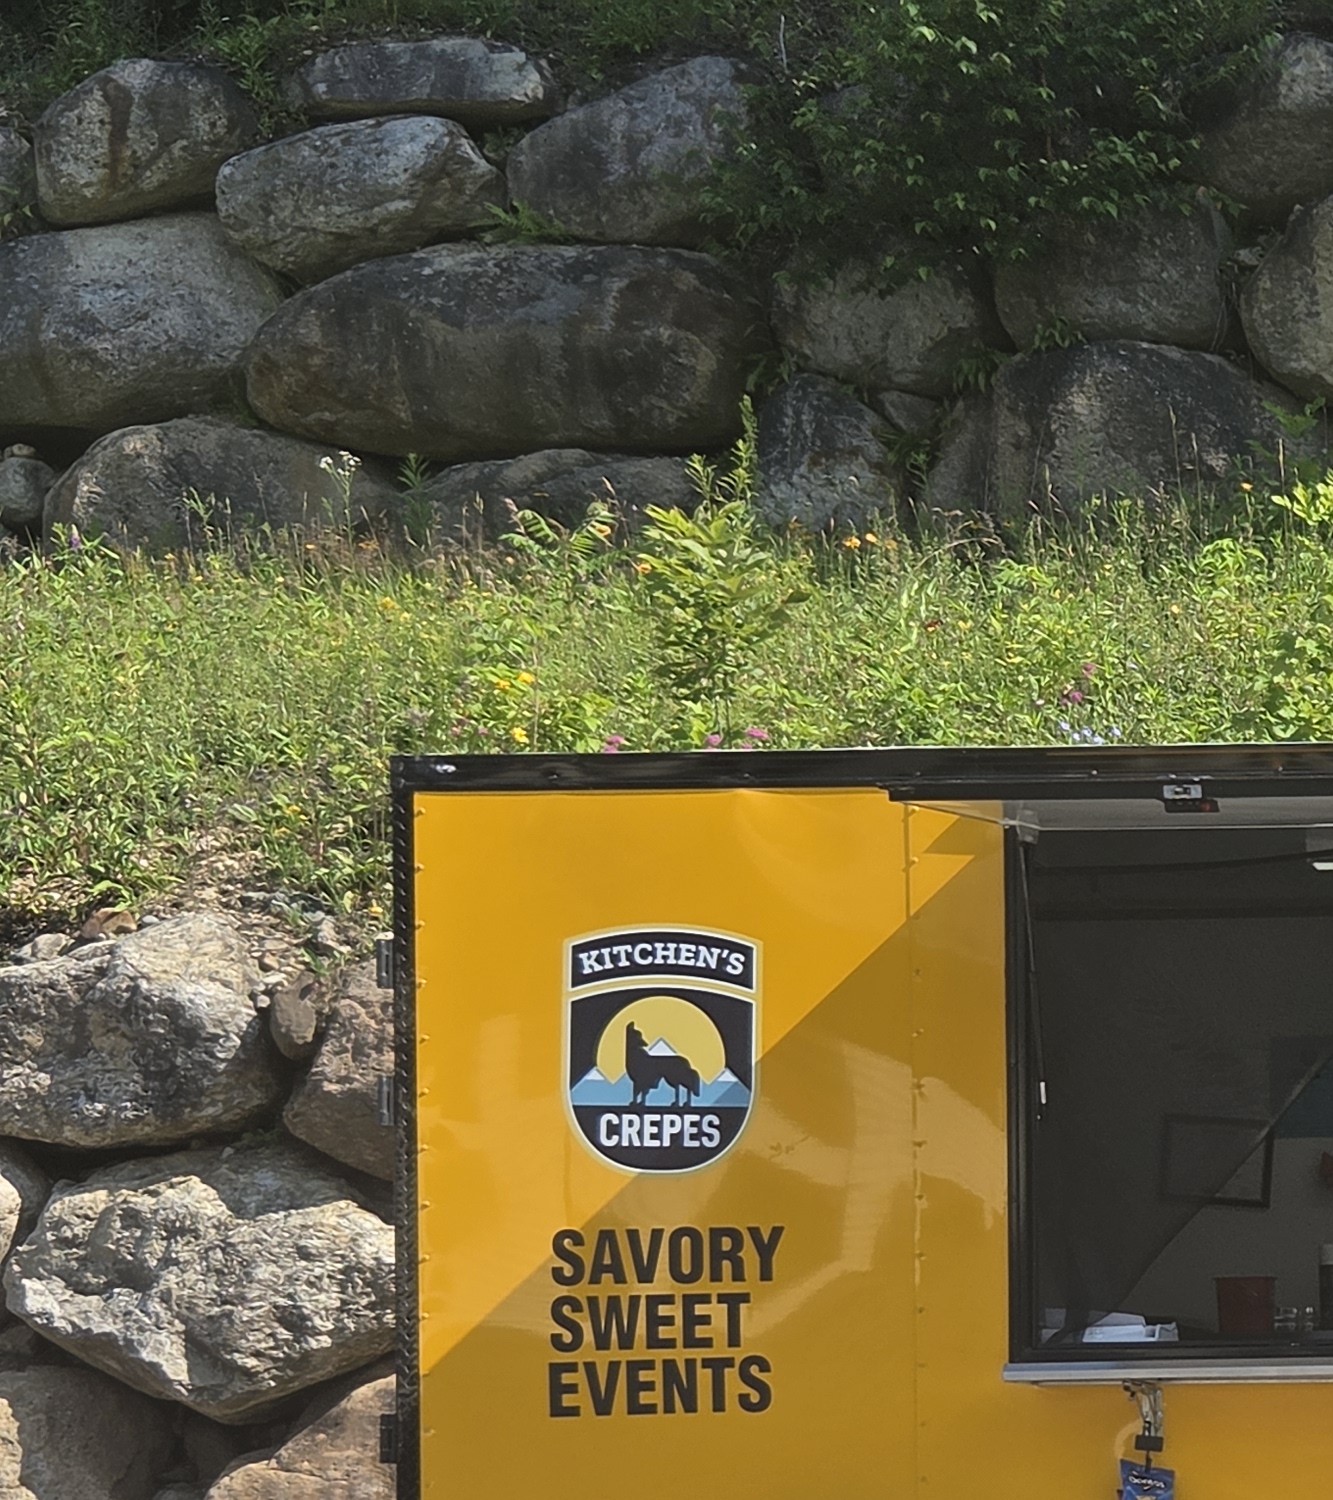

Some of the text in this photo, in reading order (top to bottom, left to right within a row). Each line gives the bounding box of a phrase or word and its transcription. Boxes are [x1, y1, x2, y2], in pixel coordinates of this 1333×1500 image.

[578, 941, 746, 977] KITCHEN'S
[598, 1111, 722, 1149] CREPES
[549, 1225, 785, 1286] SAVORY
[548, 1292, 751, 1353] SWEET
[547, 1354, 773, 1418] EVENTS
